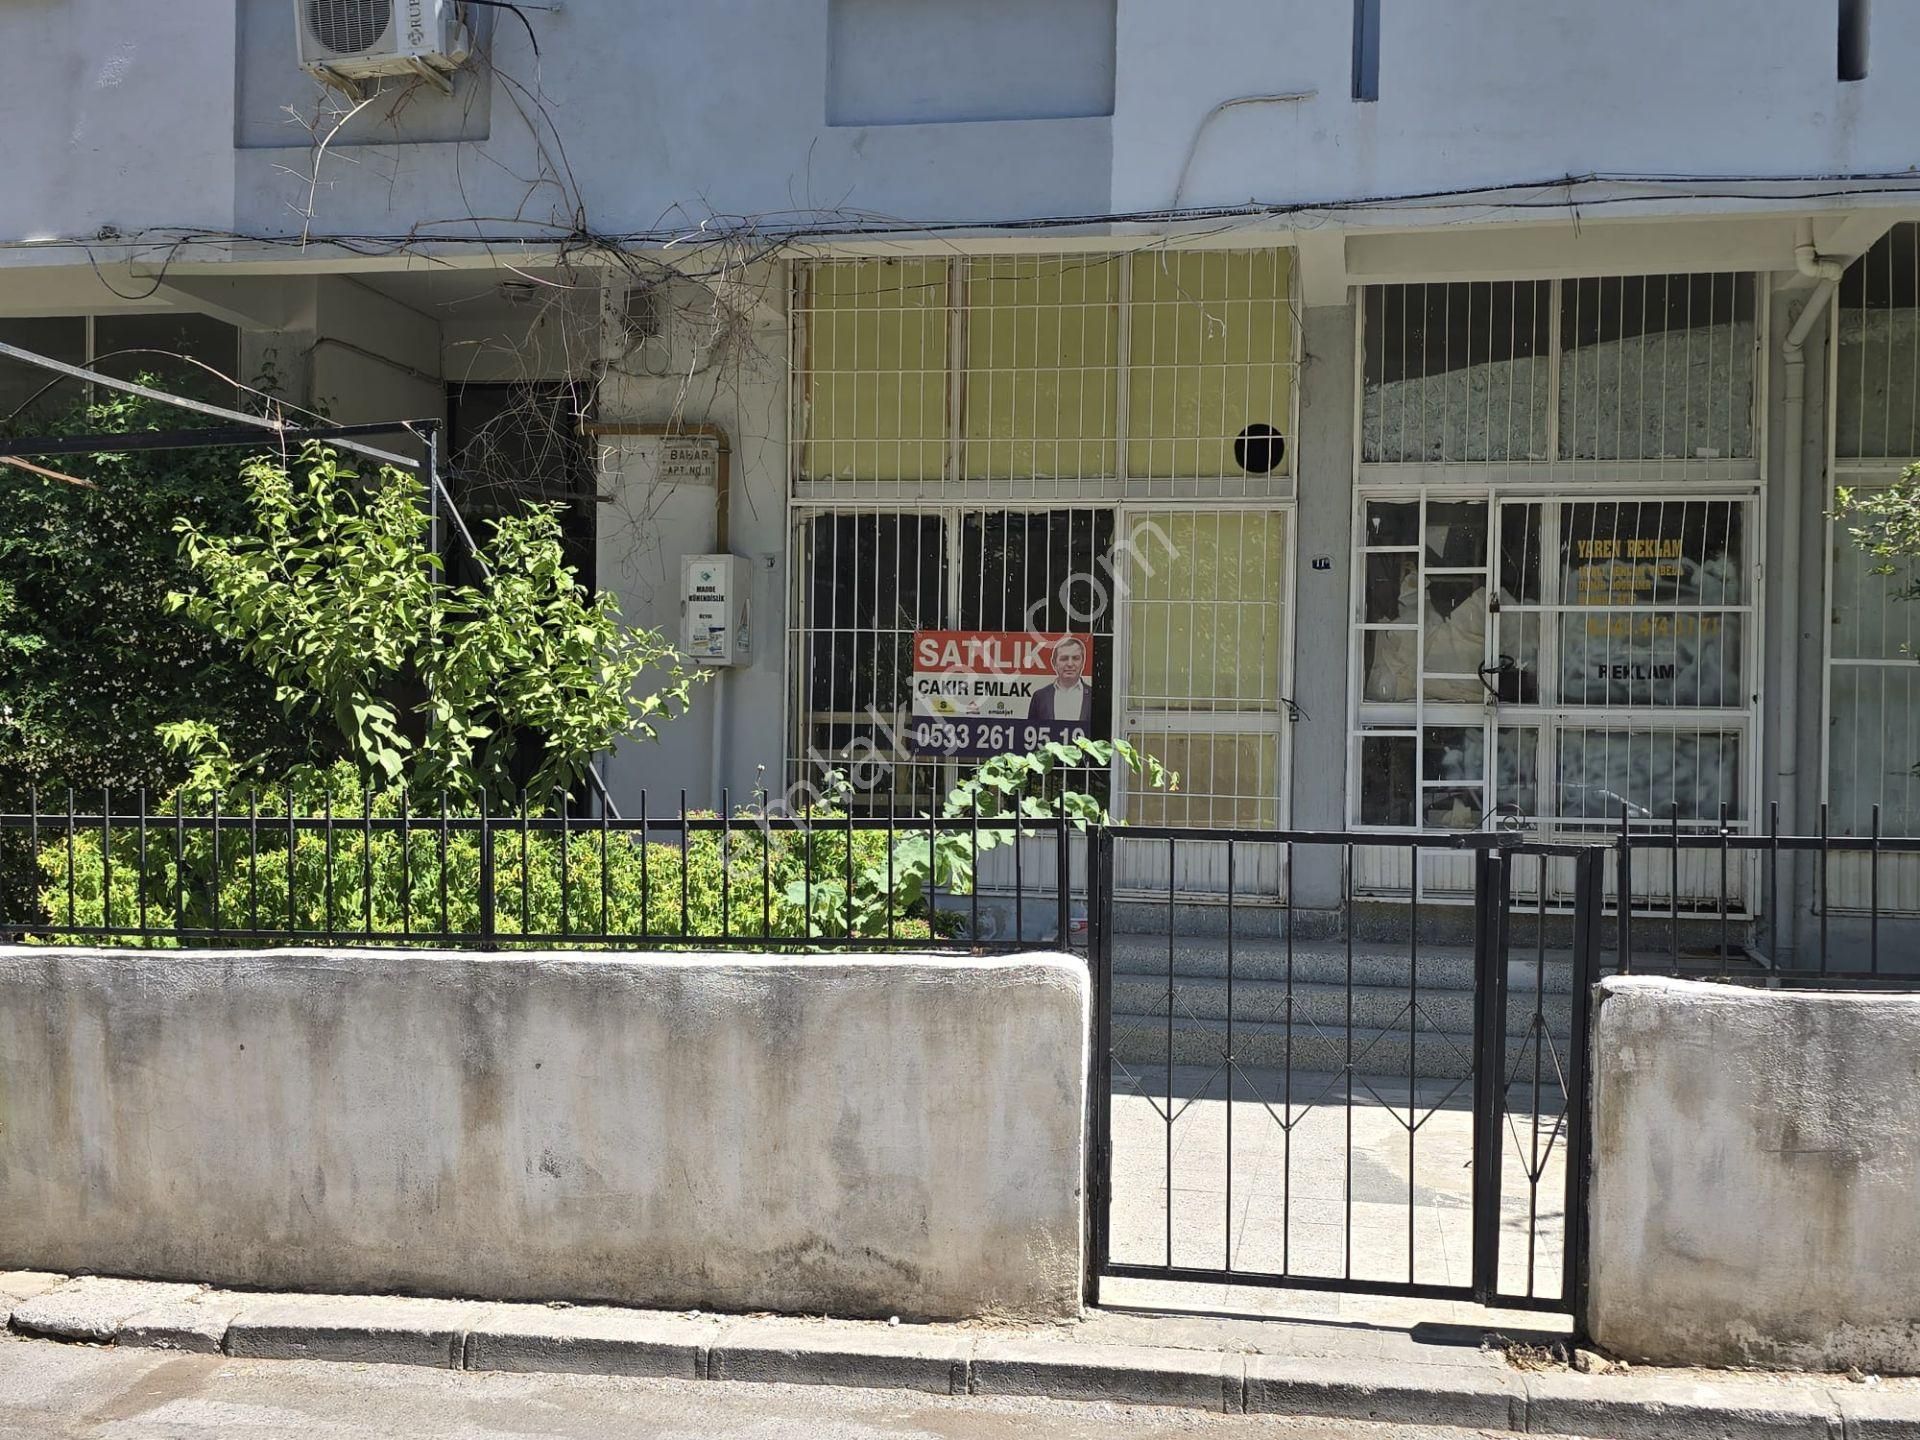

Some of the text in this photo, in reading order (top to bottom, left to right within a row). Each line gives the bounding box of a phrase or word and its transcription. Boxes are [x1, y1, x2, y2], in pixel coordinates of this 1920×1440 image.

[1577, 539, 1684, 558] YAREN REKLAM
[919, 638, 1046, 669] SATILIK
[1598, 664, 1675, 680] REKLAM
[918, 679, 1032, 699] ÇAKIR EMLAK
[917, 722, 970, 749] 0533
[977, 725, 1015, 750] 261
[1024, 727, 1051, 750] 95
